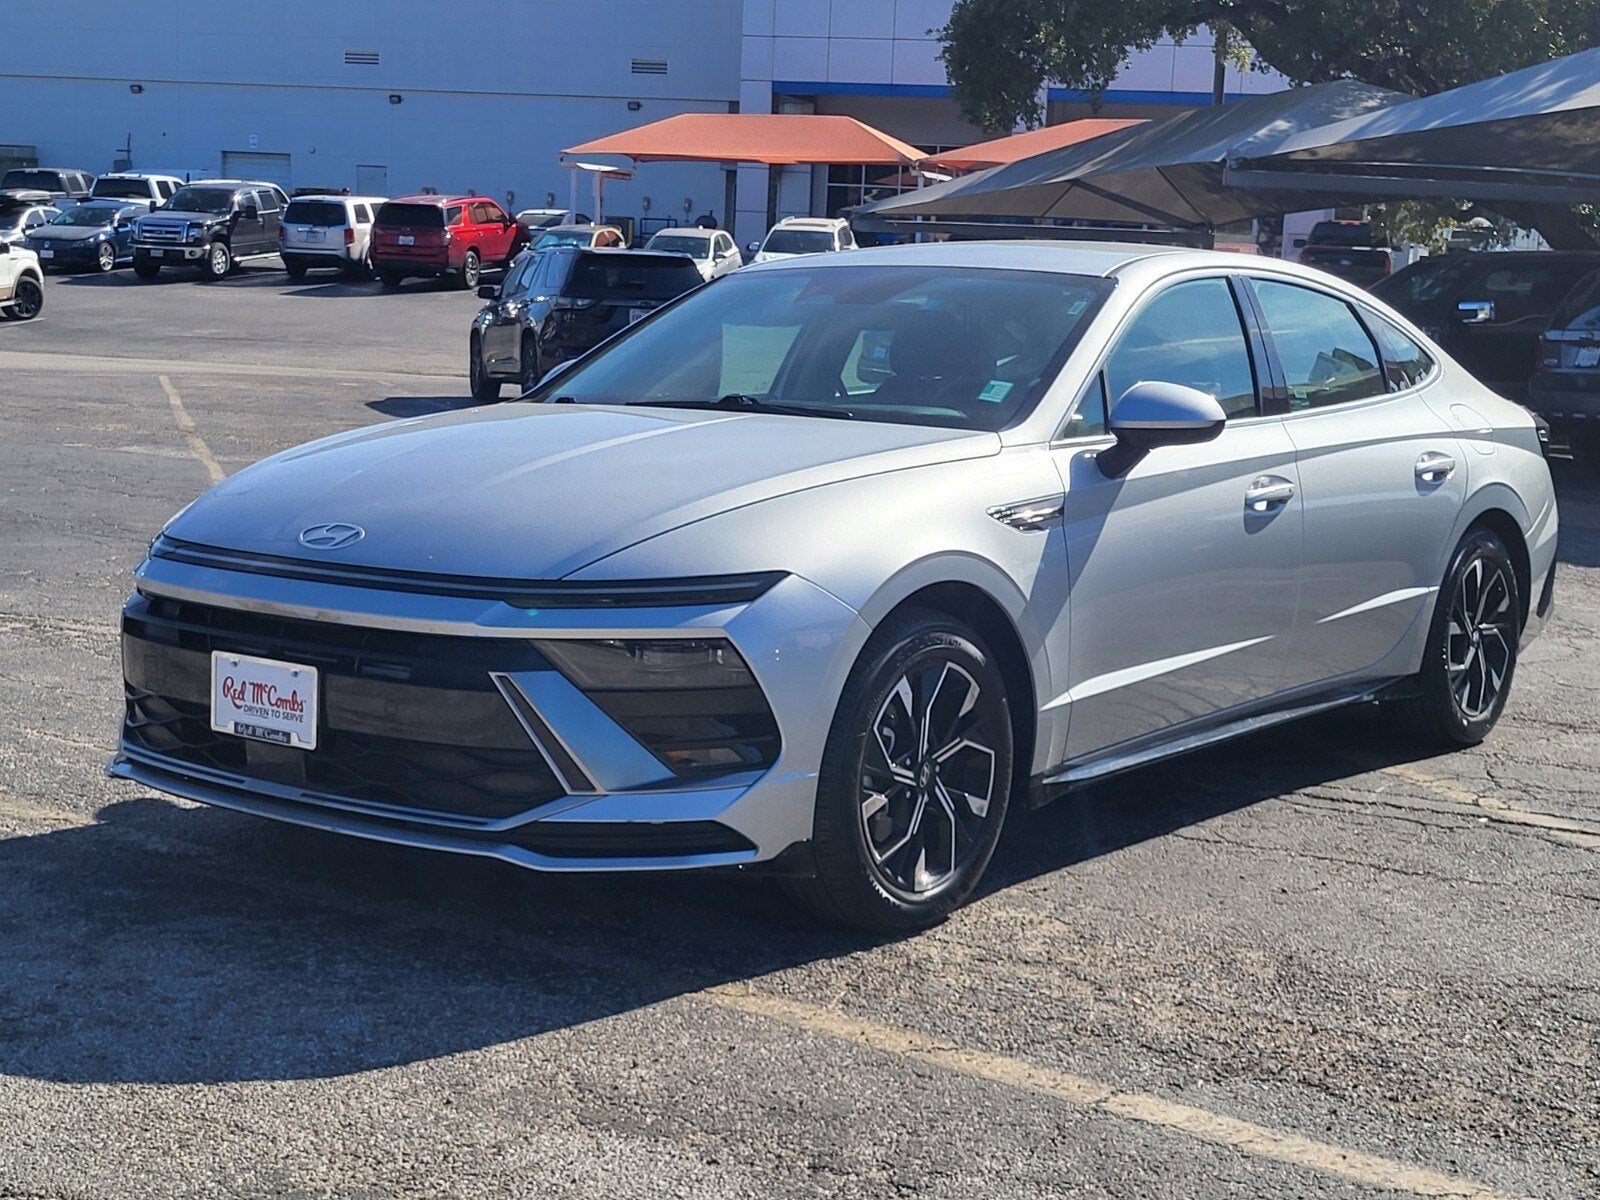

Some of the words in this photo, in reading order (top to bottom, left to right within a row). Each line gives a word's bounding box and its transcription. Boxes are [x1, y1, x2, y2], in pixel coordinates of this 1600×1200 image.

[223, 676, 246, 709] Red
[249, 682, 304, 713] McCombs
[243, 705, 269, 717] DRIVEN
[271, 709, 281, 719] TO
[282, 711, 304, 722] SERVE
